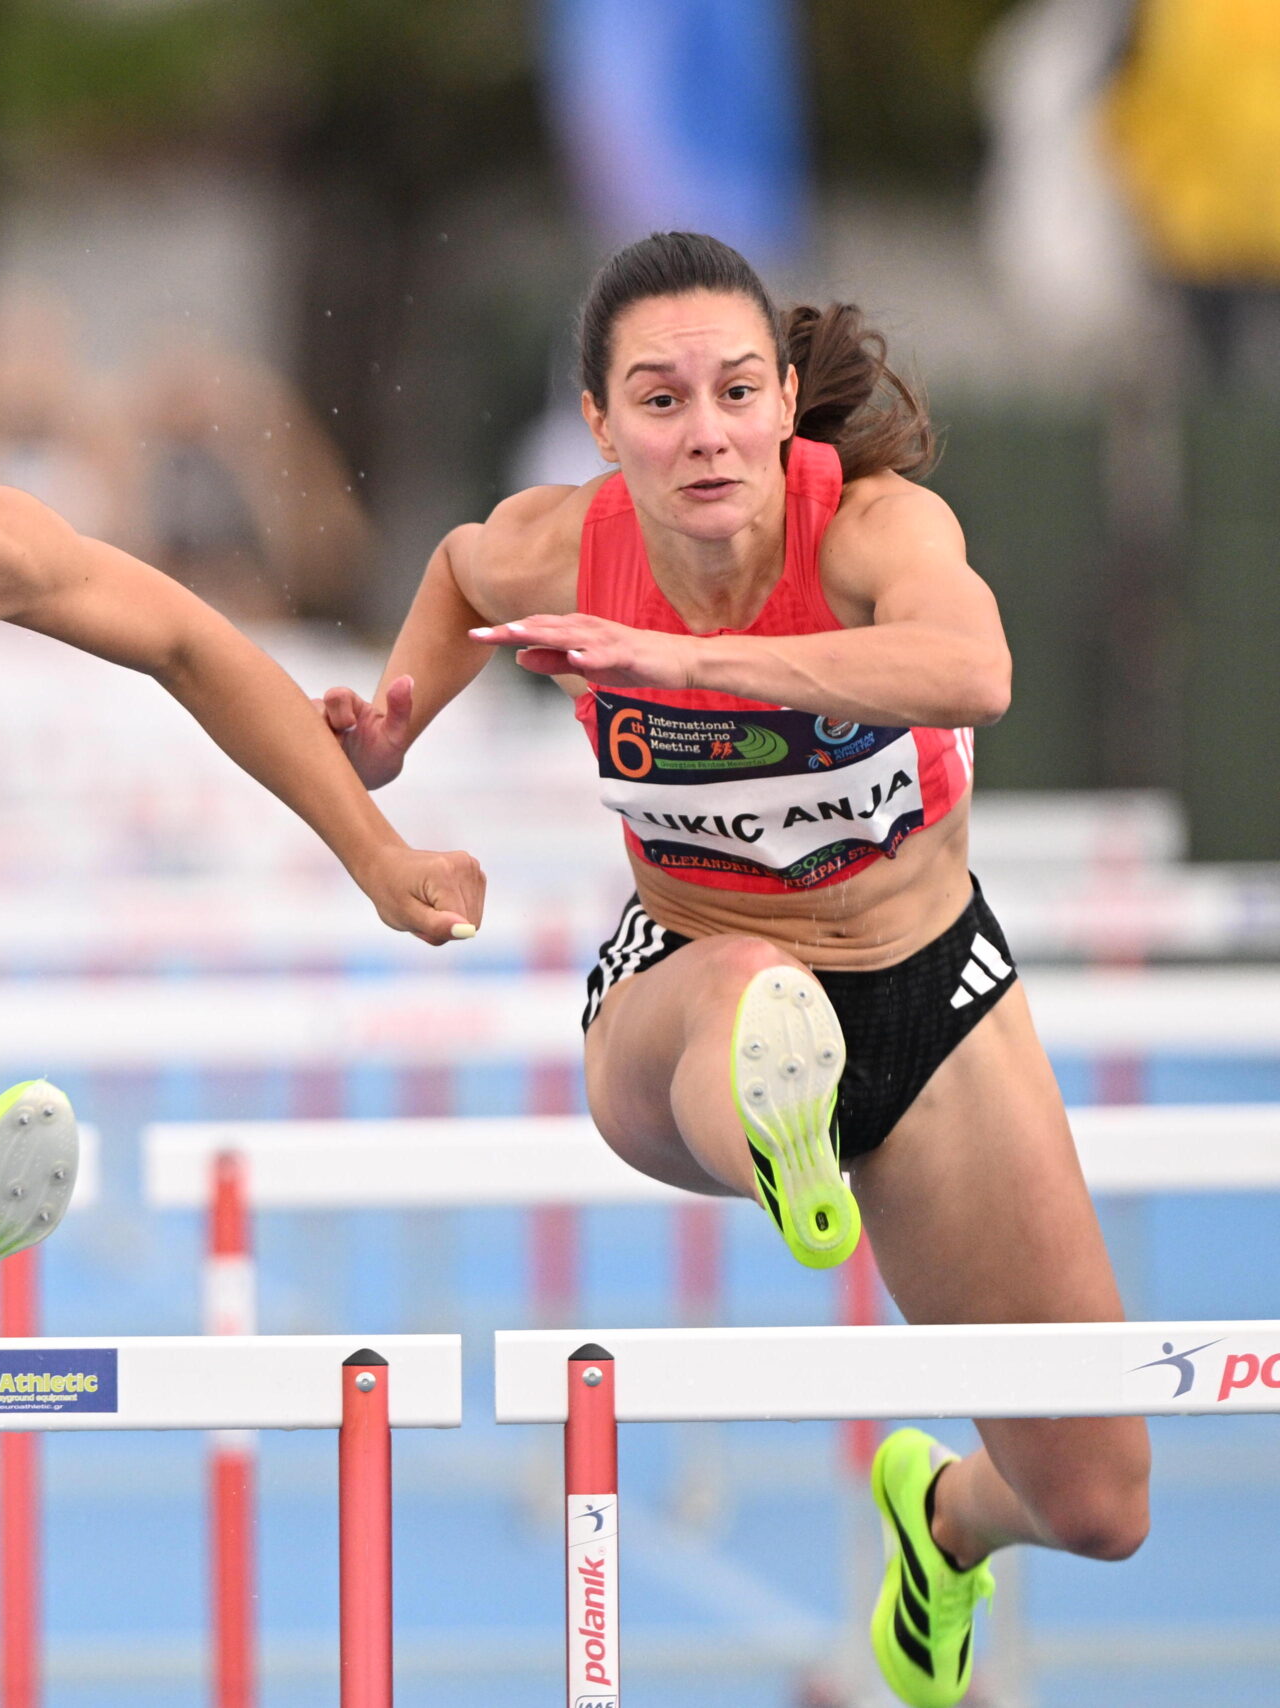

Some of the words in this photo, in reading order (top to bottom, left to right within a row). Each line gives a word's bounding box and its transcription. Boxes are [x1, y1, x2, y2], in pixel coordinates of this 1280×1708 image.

[647, 714, 737, 730] International
[649, 727, 731, 742] Alexandrino
[650, 739, 701, 753] Meeting
[783, 769, 913, 828] ANJA
[660, 854, 760, 877] ALEXANDRIA
[36, 1394, 78, 1403] equipment
